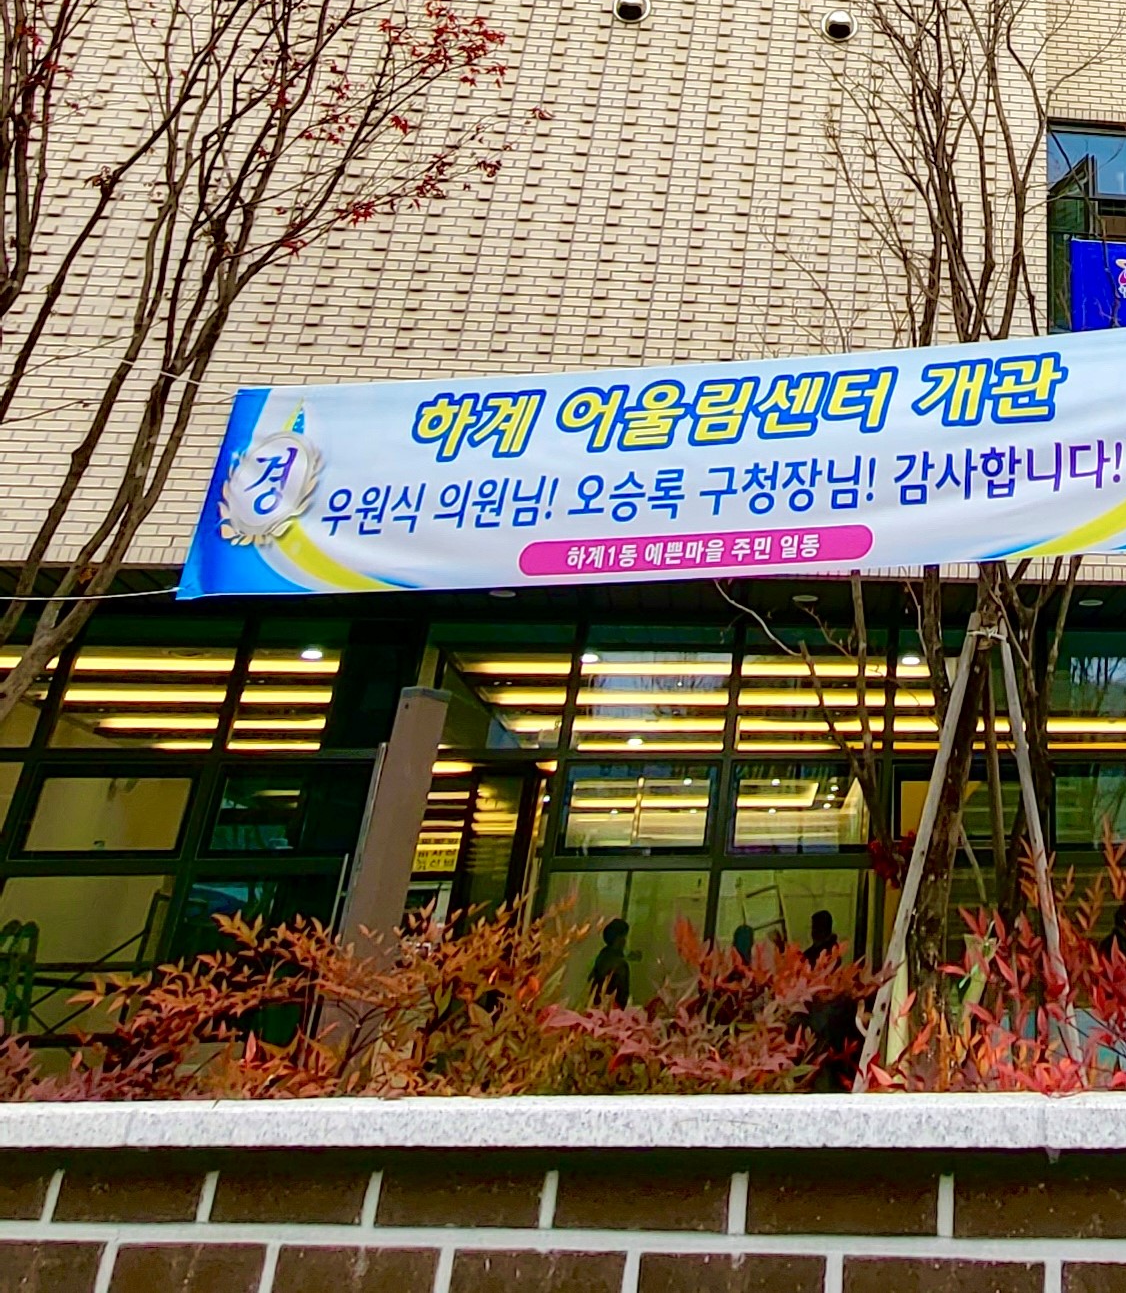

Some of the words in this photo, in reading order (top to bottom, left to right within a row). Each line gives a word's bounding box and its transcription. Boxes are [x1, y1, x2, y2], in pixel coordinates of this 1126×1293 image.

[412, 390, 544, 462] 하계
[555, 361, 898, 453] 어울림센터
[911, 352, 1067, 429] 개관
[243, 447, 298, 516] 경
[321, 483, 425, 536] 우원식
[432, 471, 559, 533] 의원님!
[567, 468, 687, 523] 오승록
[698, 456, 877, 518] 구청장님!
[567, 544, 639, 570] 하계1동
[644, 538, 725, 566] 예쁜마을
[731, 536, 772, 563] 주민
[780, 533, 820, 559] 일동
